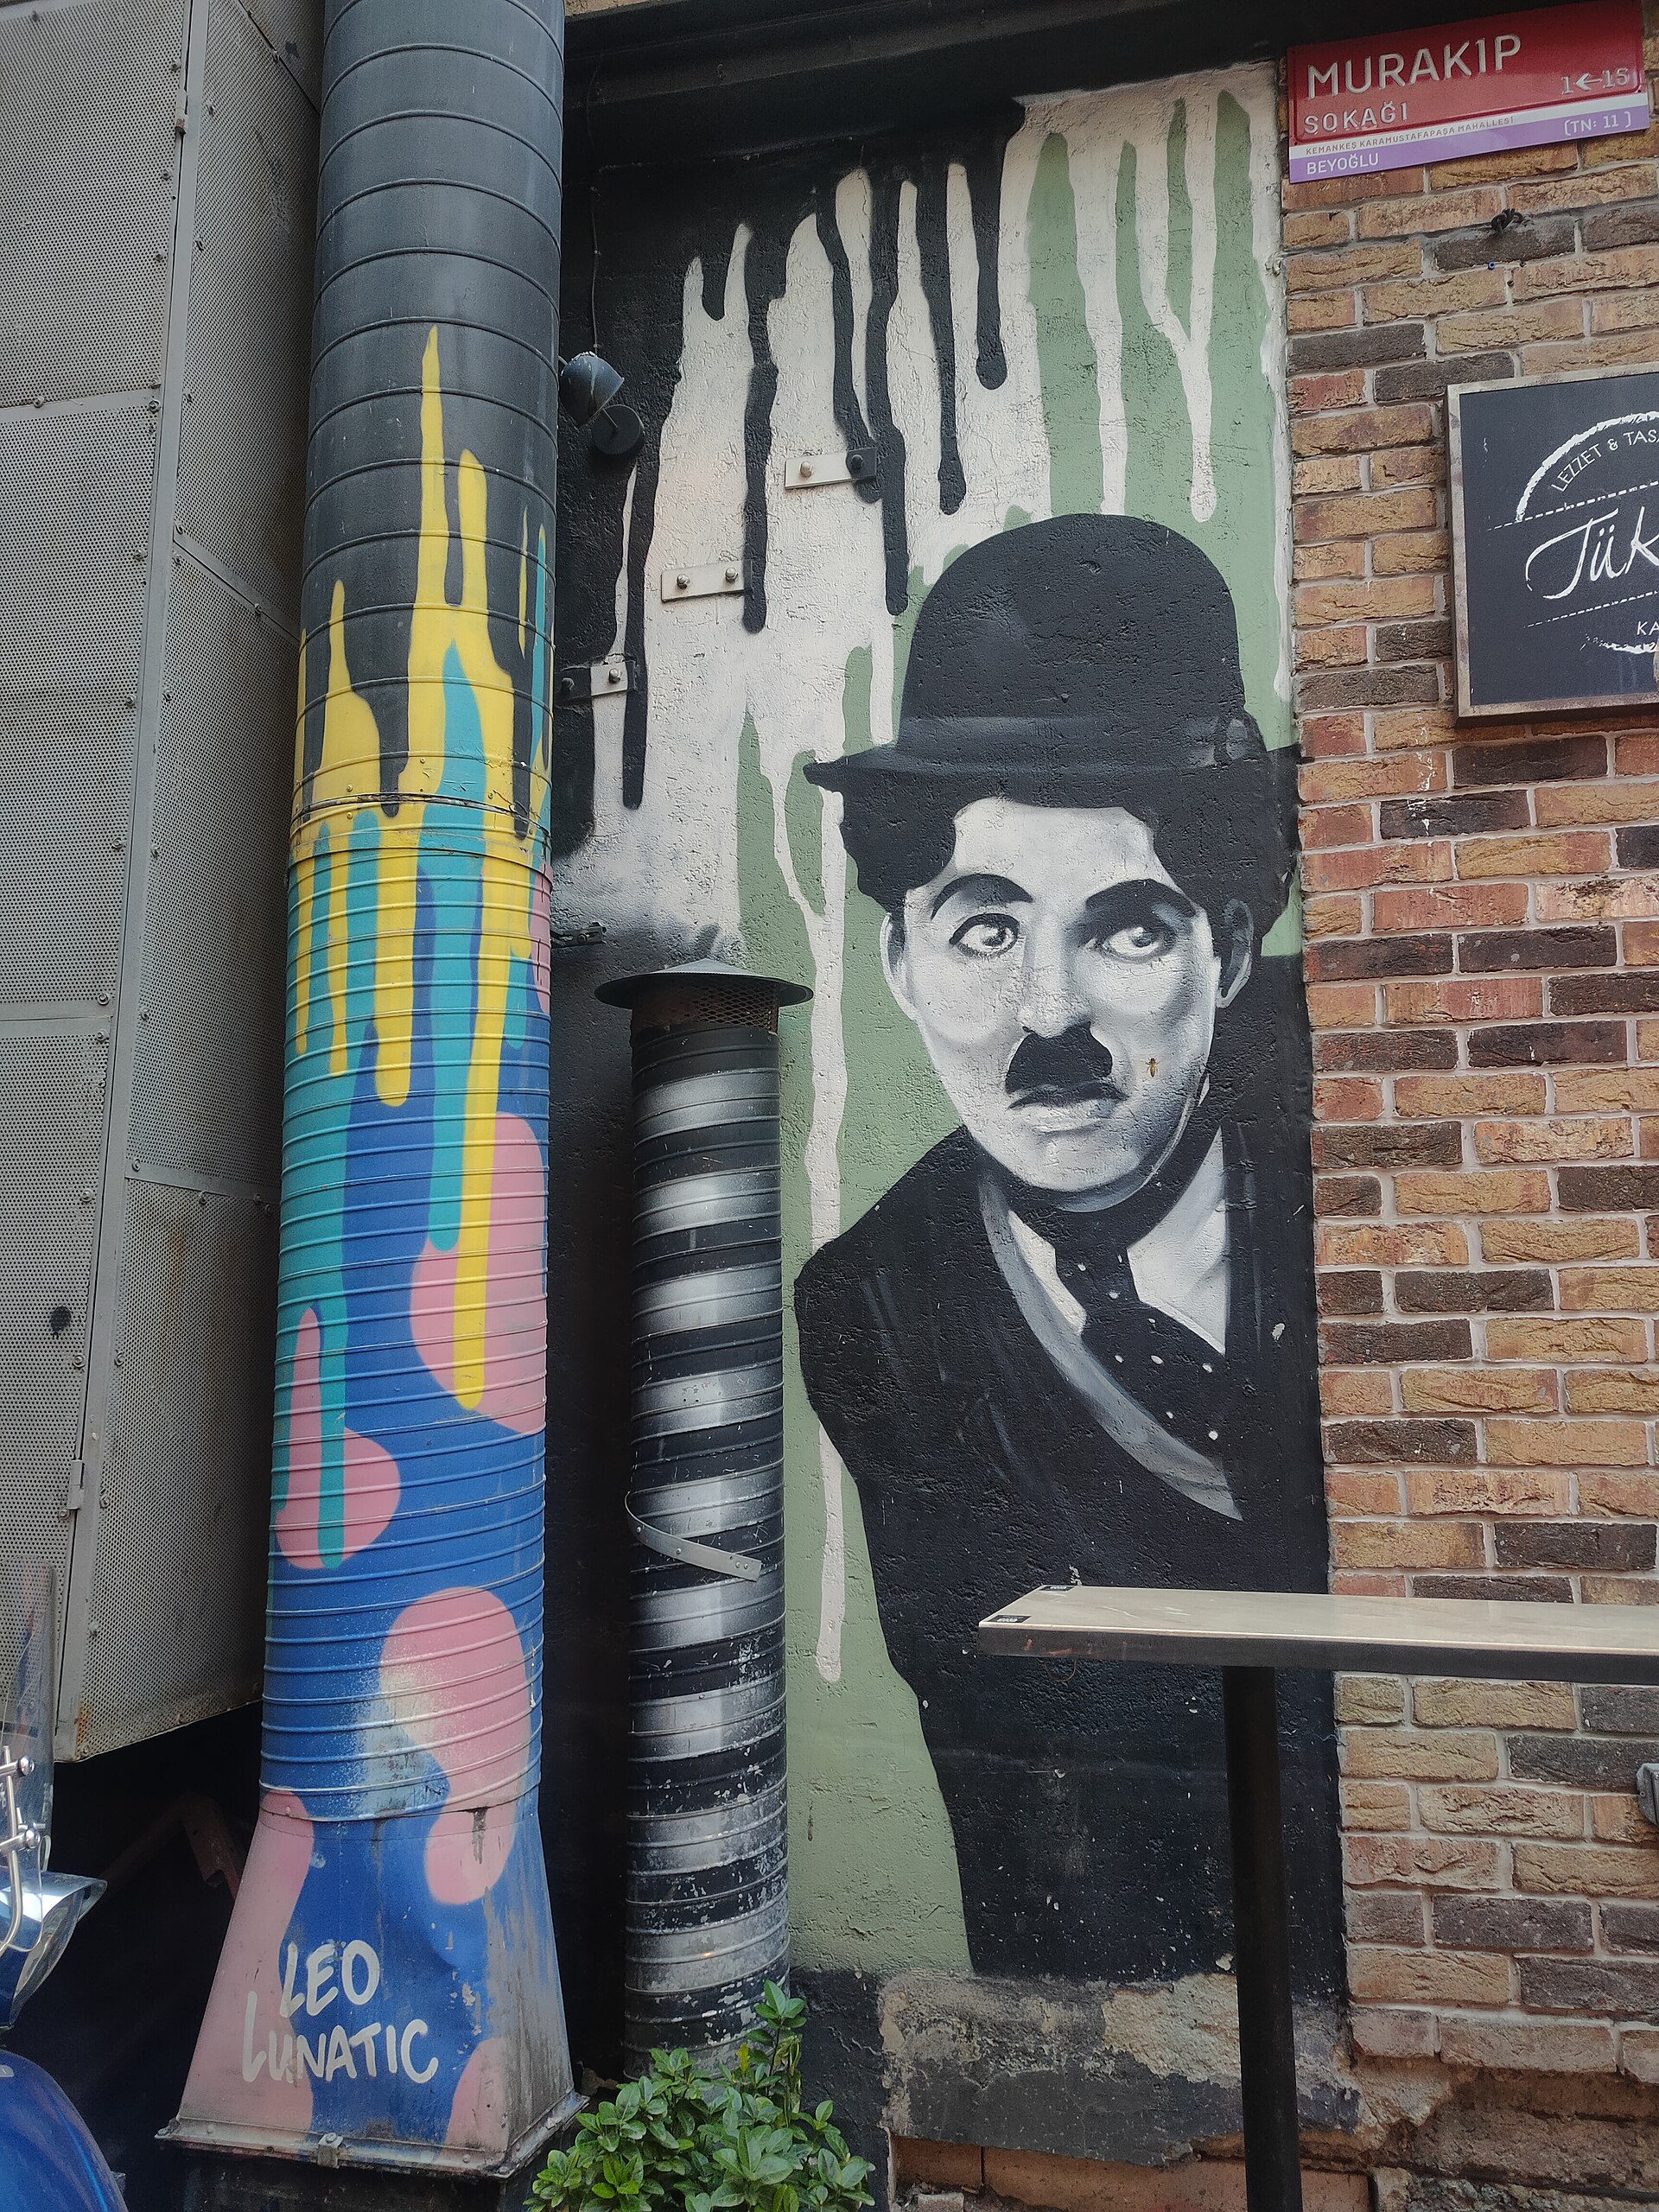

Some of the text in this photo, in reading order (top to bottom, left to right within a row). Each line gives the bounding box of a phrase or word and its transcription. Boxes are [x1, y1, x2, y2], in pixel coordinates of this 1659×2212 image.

[1306, 33, 1522, 101] MURAKIP
[1601, 67, 1630, 88] 15
[1303, 100, 1408, 136] SOKAĞI
[1306, 116, 1514, 156] KEMANKEŞ KARAMUSTAFAPAŞA MAHALLESİ
[1306, 152, 1380, 175] BEYOĞLU
[1550, 429, 1659, 493] LEZZET & TAS
[279, 1938, 381, 2019] LEO
[241, 1990, 440, 2085] LUNATIC
